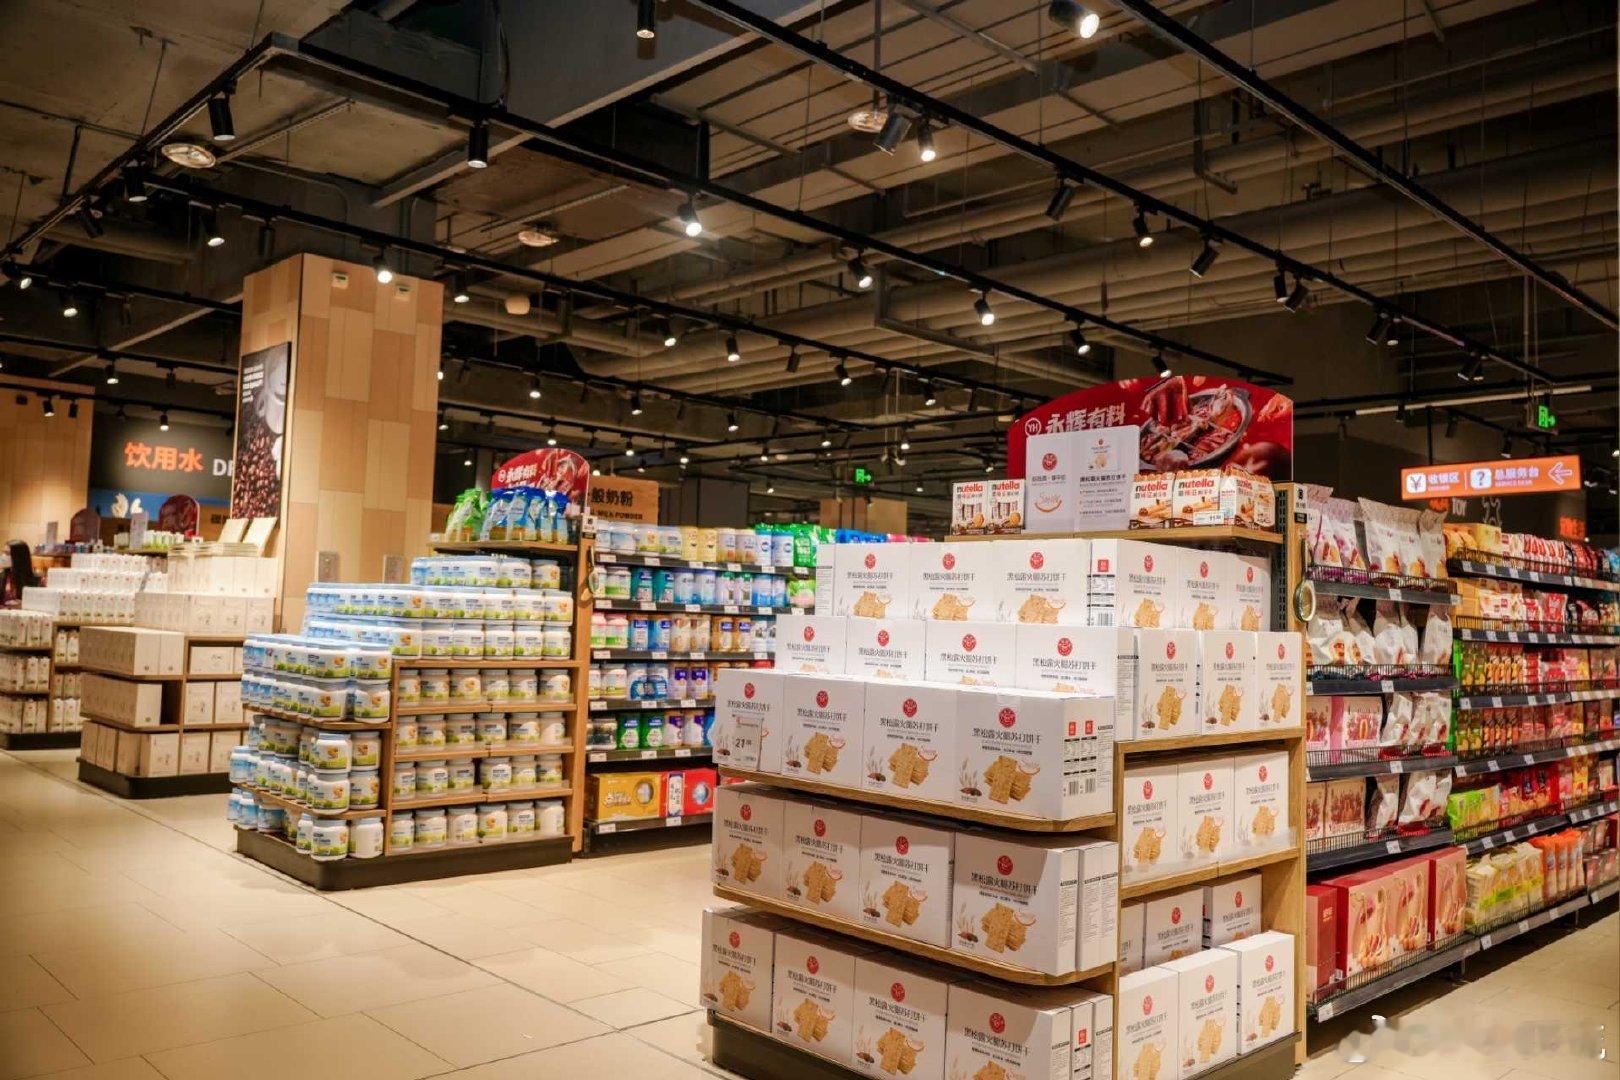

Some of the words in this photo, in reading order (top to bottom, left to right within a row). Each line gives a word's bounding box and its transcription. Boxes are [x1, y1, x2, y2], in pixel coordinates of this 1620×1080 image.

[1046, 402, 1126, 433] 永辉有料
[124, 441, 204, 473] 饮用水
[956, 483, 983, 493] nutella
[992, 481, 1020, 490] nutella
[1135, 480, 1168, 492] nutella
[1178, 478, 1214, 489] nutella
